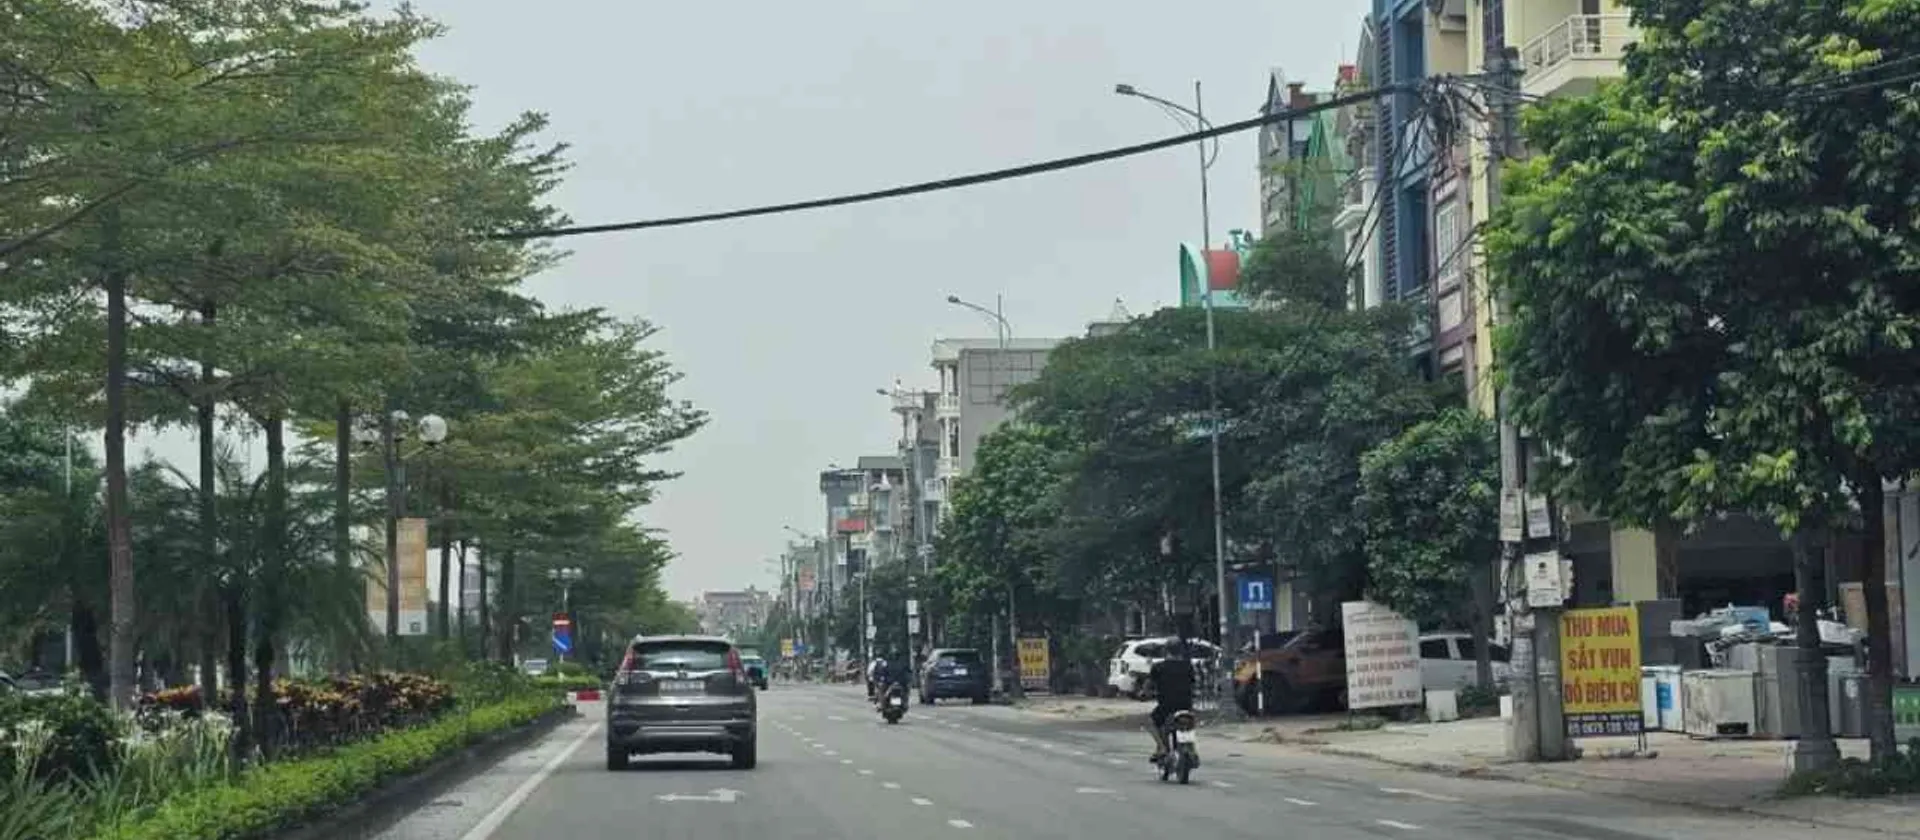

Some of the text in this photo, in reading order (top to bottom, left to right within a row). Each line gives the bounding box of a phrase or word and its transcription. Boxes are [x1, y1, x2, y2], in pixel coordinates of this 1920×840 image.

[1564, 614, 1631, 637] THU MUA
[1567, 642, 1596, 670] SẮT
